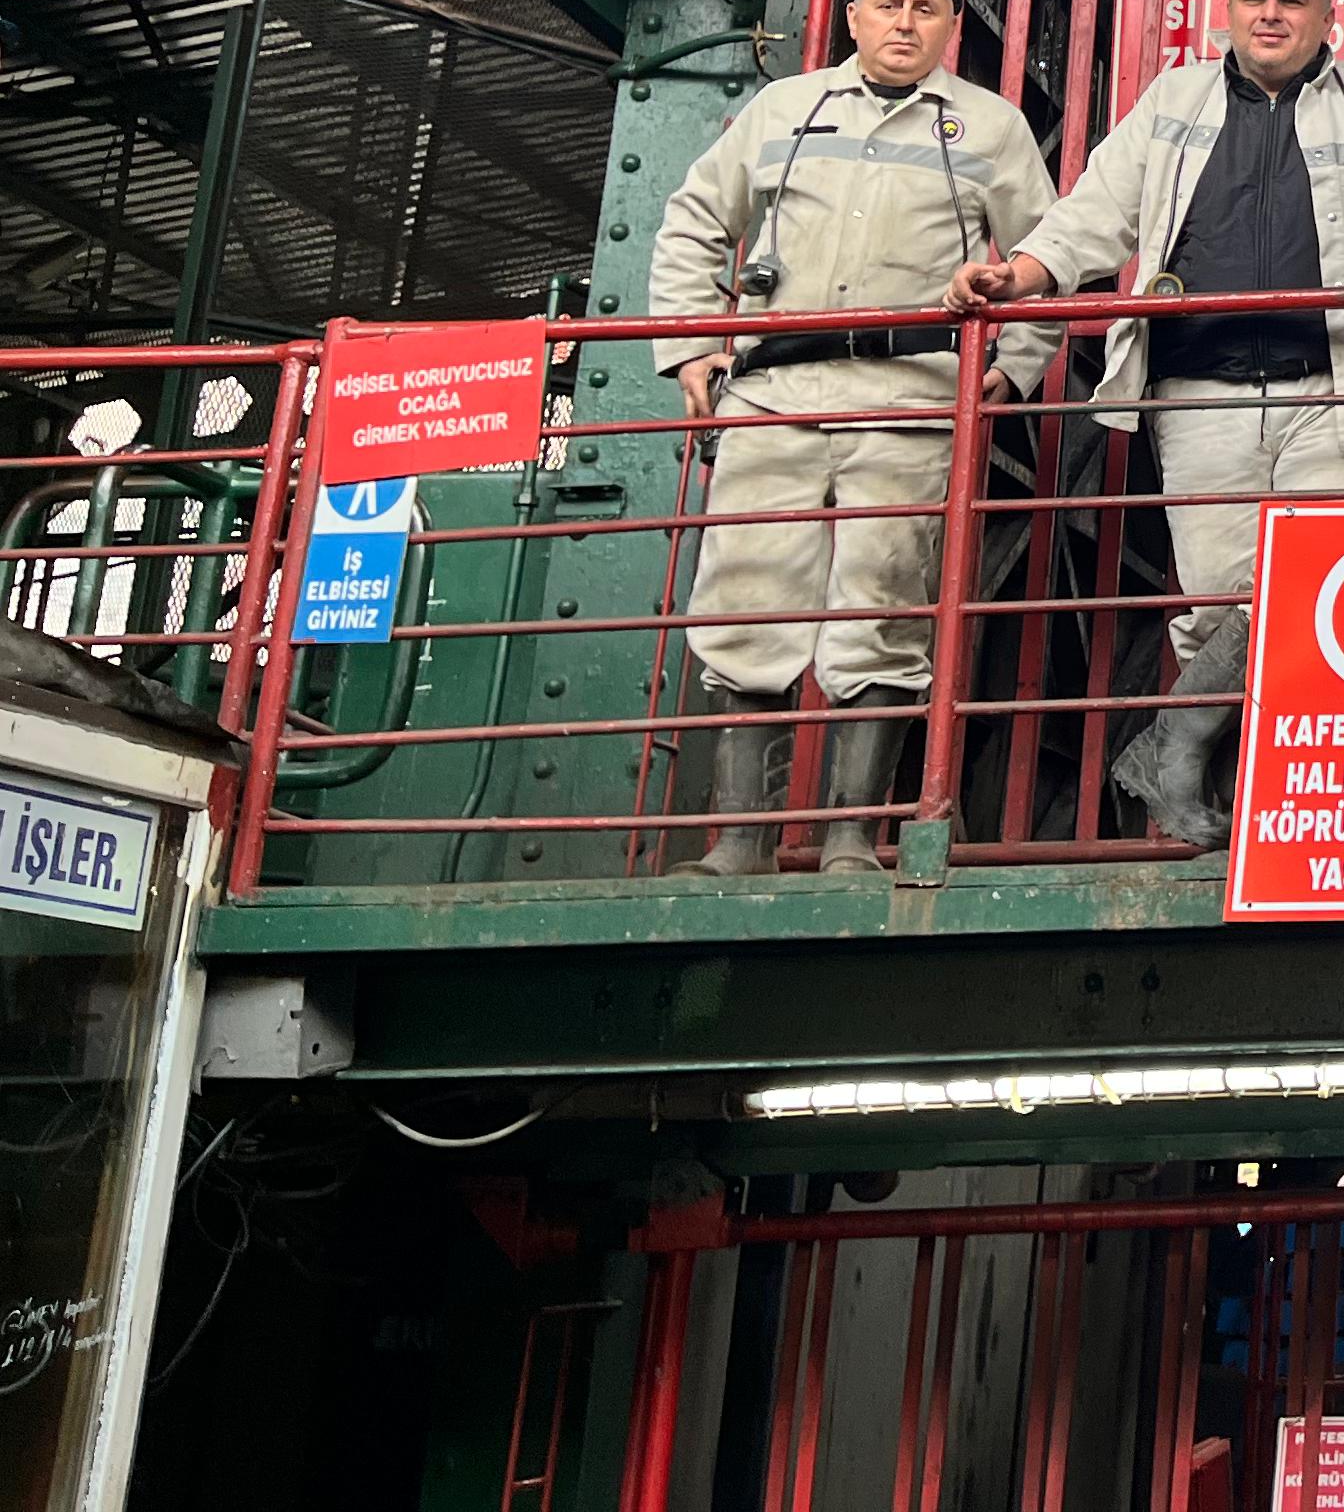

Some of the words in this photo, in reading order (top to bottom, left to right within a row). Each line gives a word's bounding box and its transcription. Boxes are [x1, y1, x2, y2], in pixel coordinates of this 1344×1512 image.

[335, 371, 399, 400] KİŞİSEL
[403, 358, 532, 388] KORUYUCUSUZ
[399, 392, 461, 415] OCAĞA
[353, 424, 419, 447] GİRMEK
[424, 412, 508, 438] YASAKTIR
[343, 547, 362, 575] İŞ
[306, 575, 390, 600] ELBİSESİ
[308, 604, 378, 630] GİYİNİZ
[11, 802, 121, 892] İŞLER.
